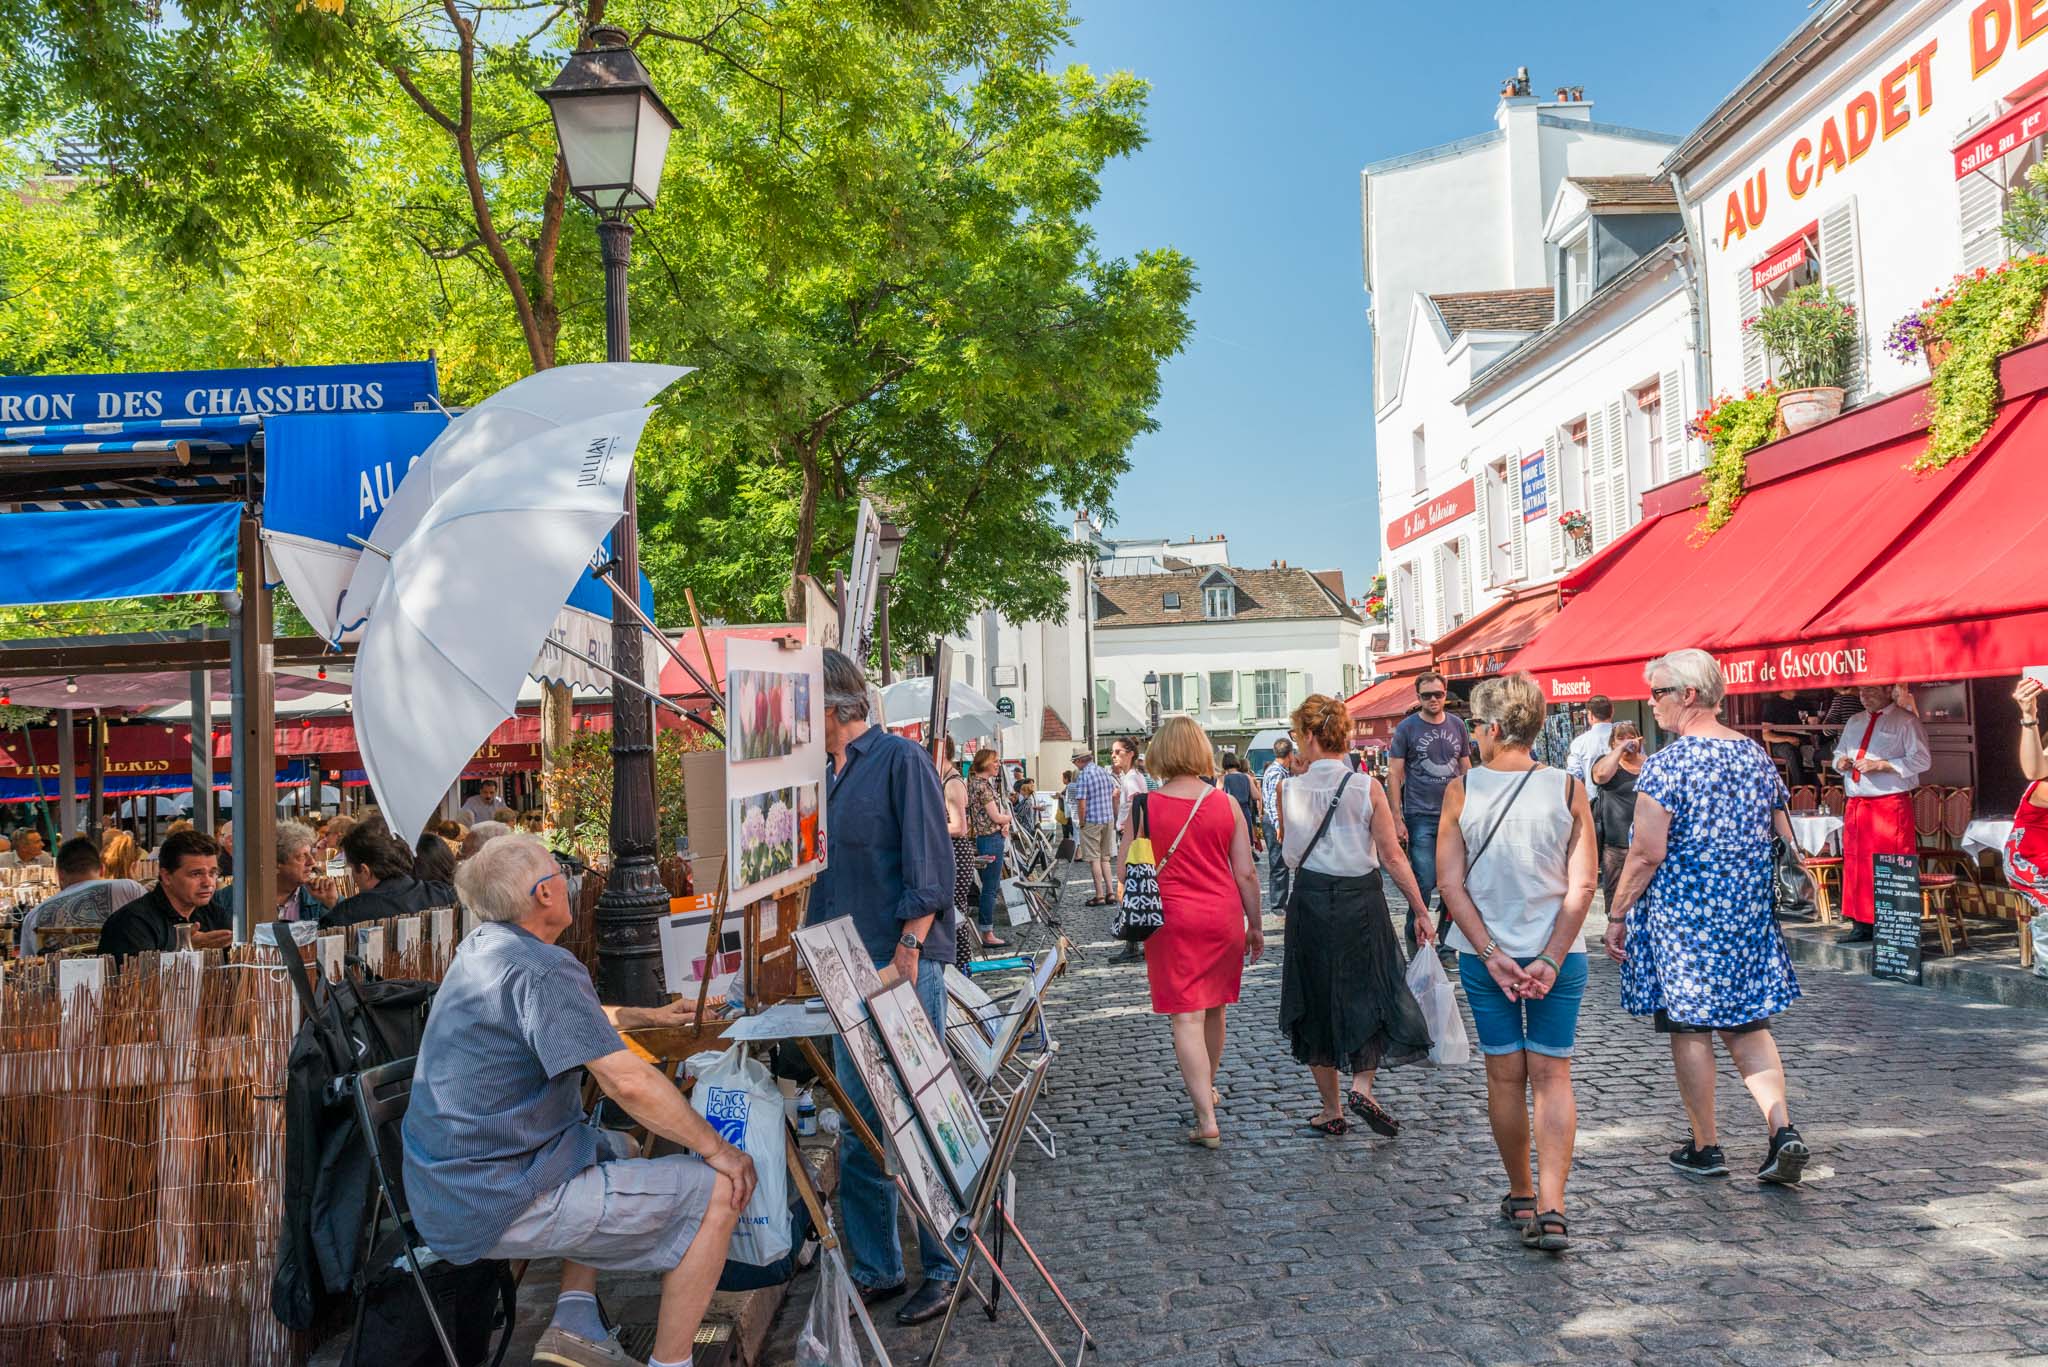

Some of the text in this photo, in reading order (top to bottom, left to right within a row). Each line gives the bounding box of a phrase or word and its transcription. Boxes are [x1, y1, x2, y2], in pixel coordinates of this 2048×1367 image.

[1722, 167, 1768, 252] AU
[1786, 37, 1938, 201] CADET
[1961, 143, 1994, 173] salle
[1998, 133, 2015, 152] au
[1755, 247, 1802, 287] Restaurant
[97, 391, 163, 418] DES
[184, 382, 384, 415] CHASSEURS
[1716, 648, 1868, 685] ADET de GASCOGNE
[1552, 677, 1592, 697] Brasserie
